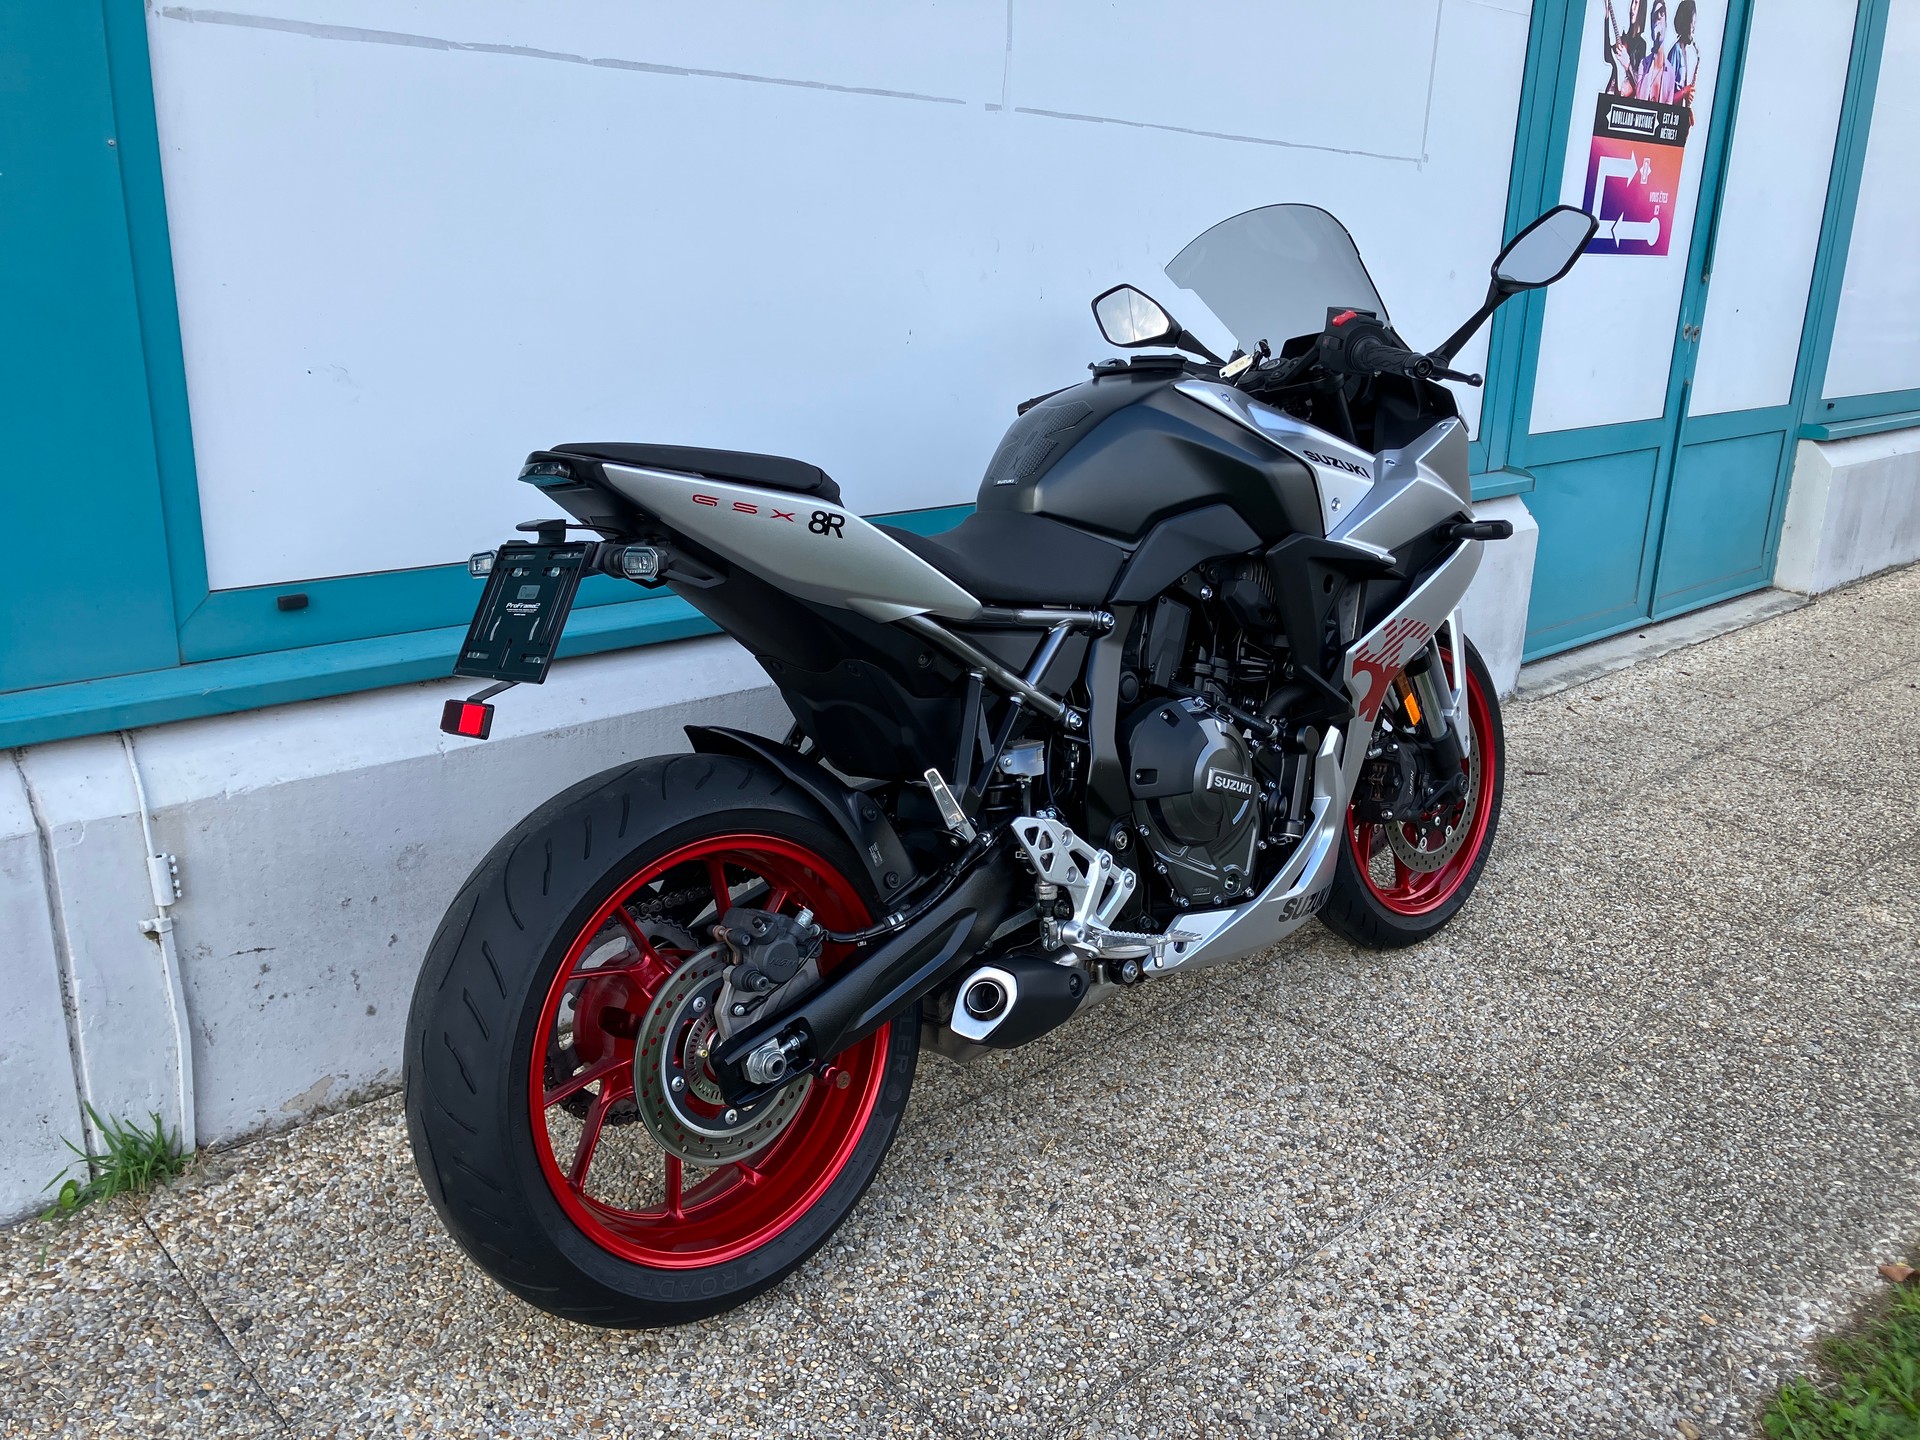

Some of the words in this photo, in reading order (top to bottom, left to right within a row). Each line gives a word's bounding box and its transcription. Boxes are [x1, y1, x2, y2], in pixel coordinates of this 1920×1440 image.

[1303, 449, 1371, 479] SUZUKI
[808, 510, 846, 539] 8R
[1214, 775, 1252, 795] SUZUKI
